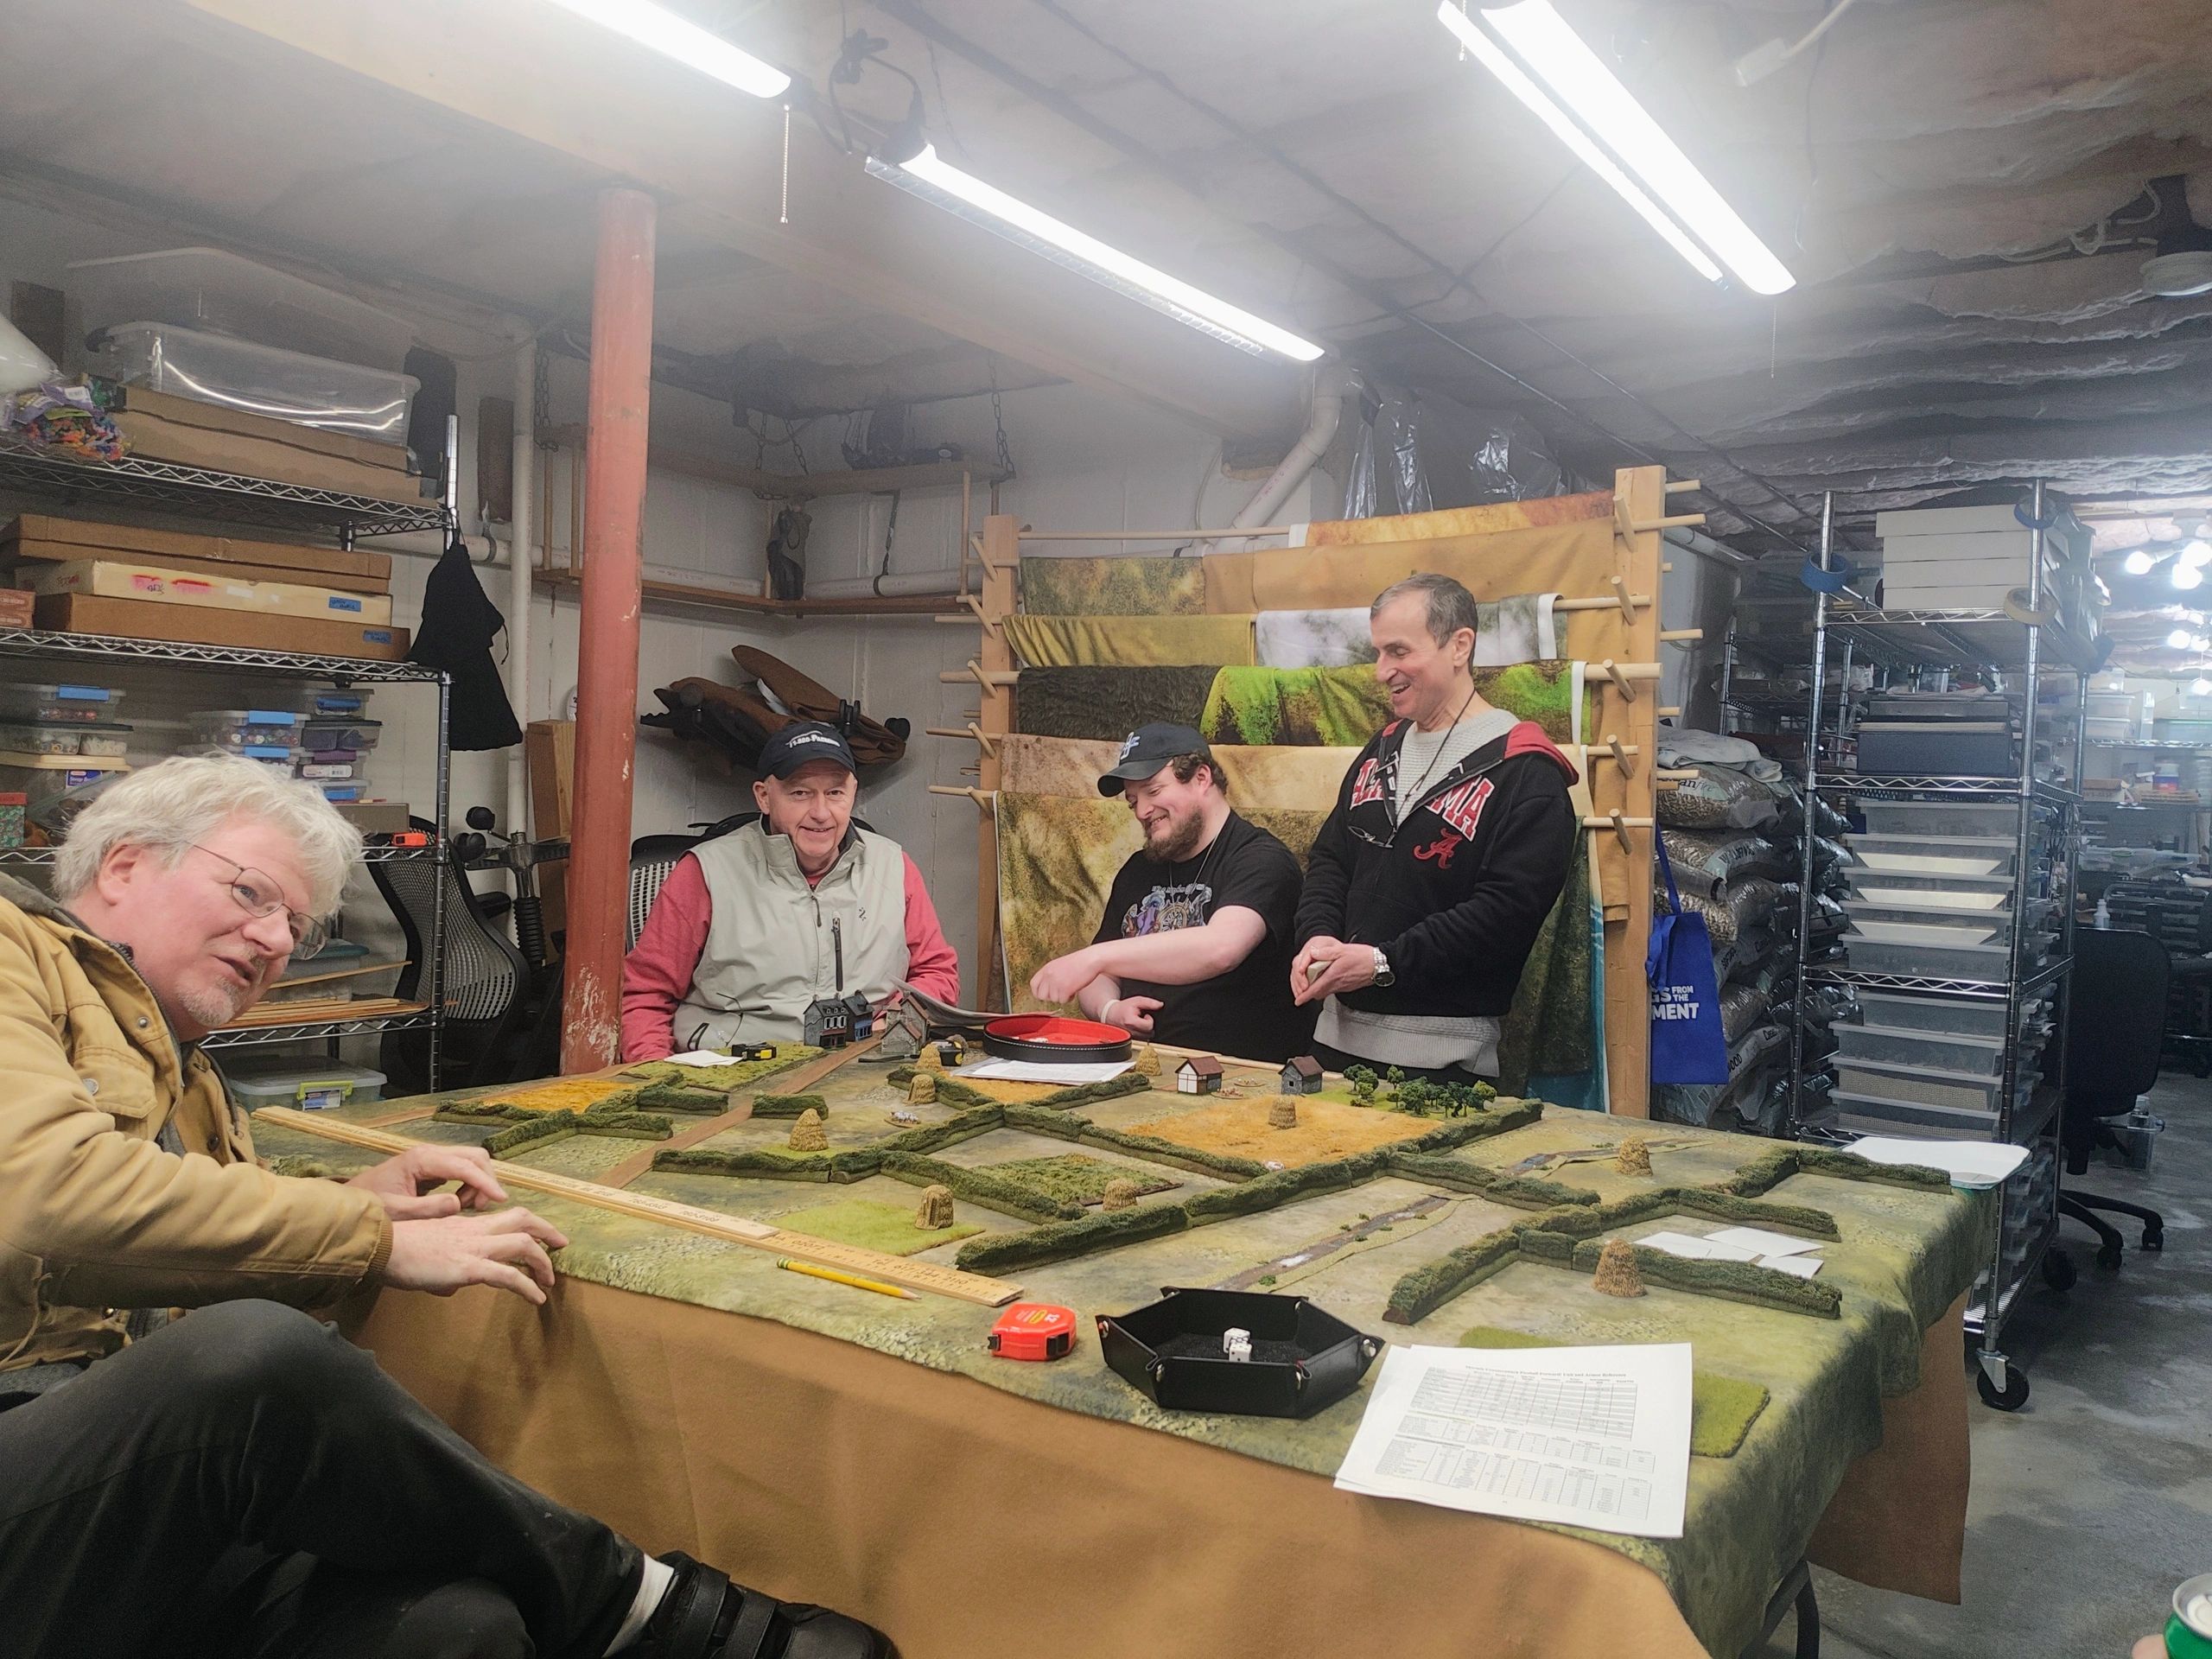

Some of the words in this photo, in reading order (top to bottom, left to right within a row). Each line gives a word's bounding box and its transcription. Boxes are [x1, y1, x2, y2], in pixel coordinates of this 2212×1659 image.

[1651, 987, 1672, 1003] GS
[1671, 985, 1694, 994] FROM
[1673, 993, 1689, 1001] THE
[1651, 1002, 1700, 1020] MENT
